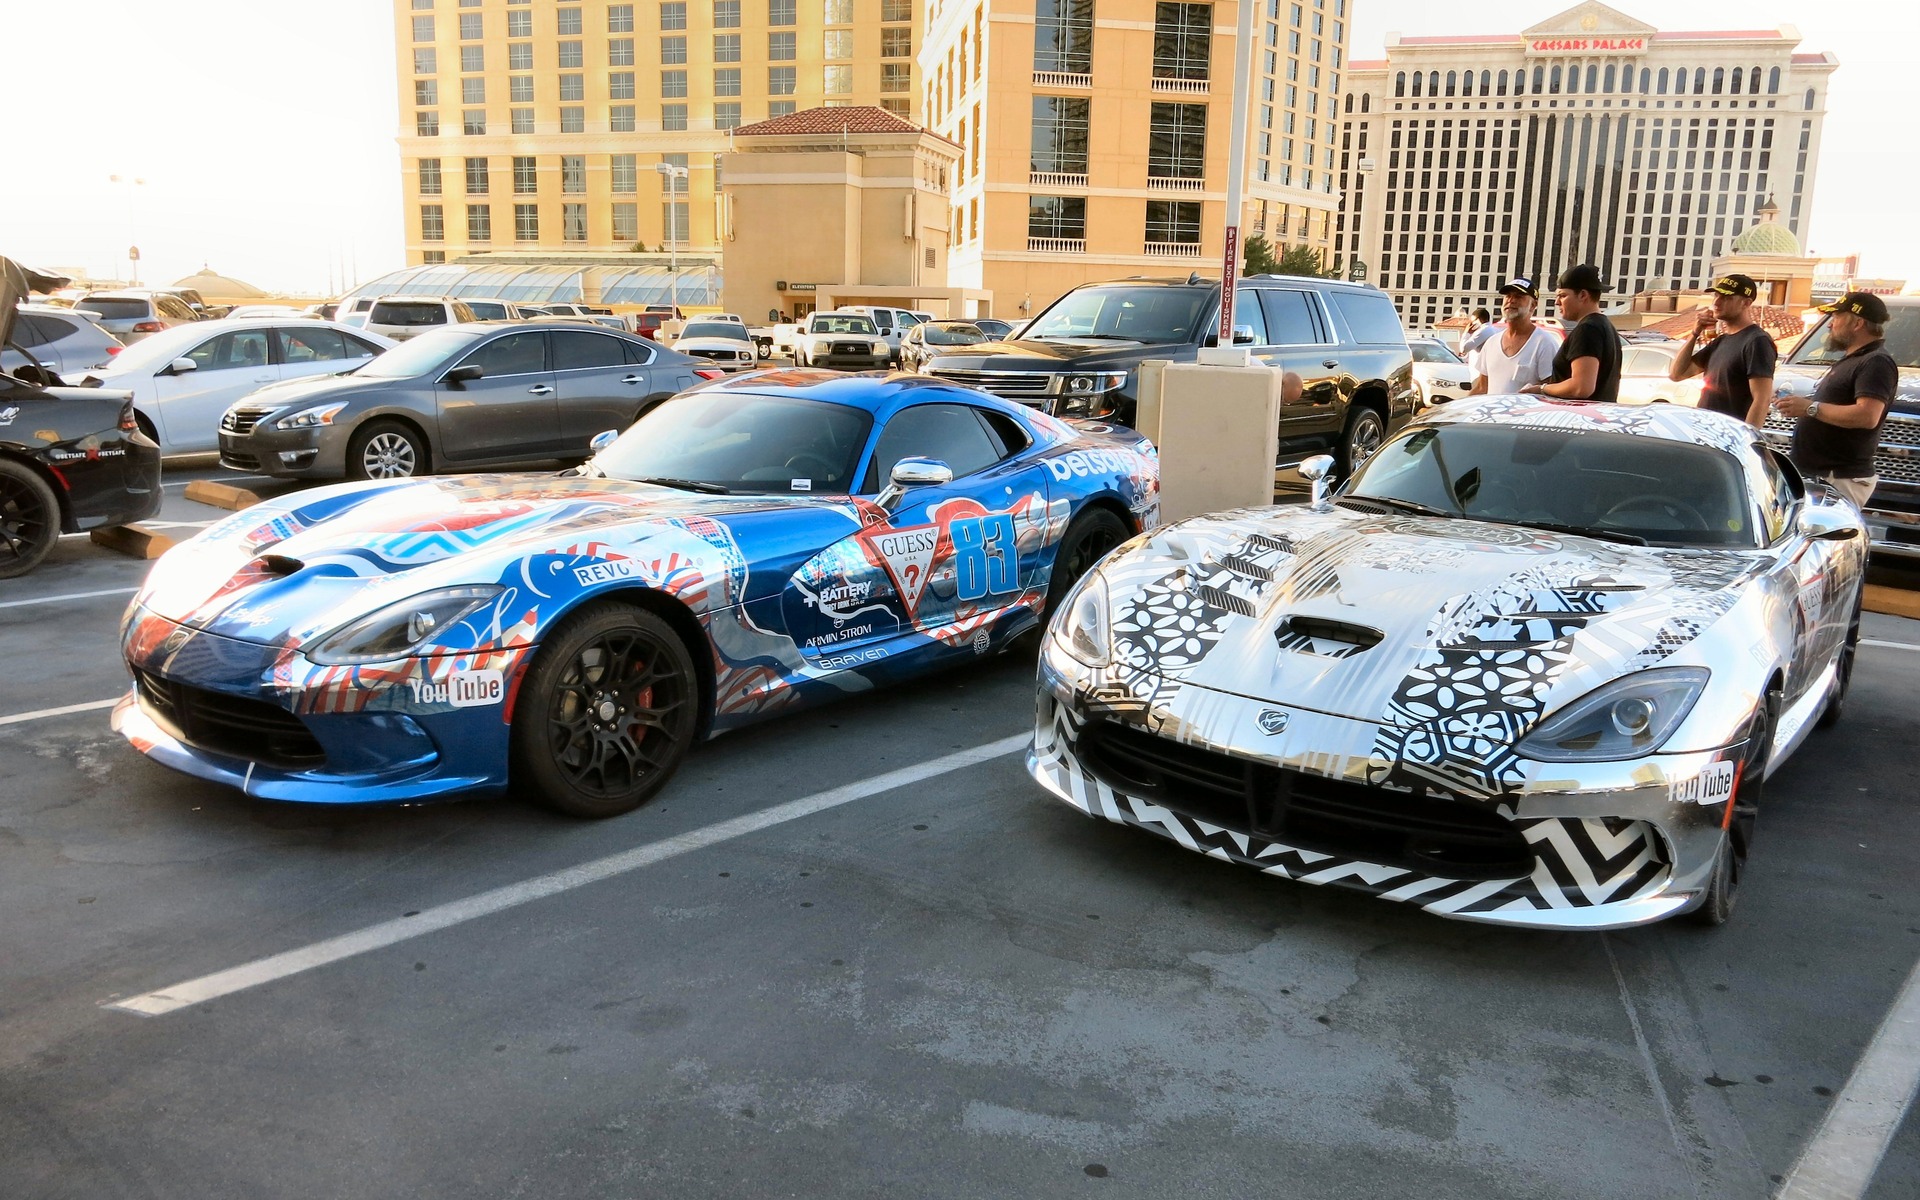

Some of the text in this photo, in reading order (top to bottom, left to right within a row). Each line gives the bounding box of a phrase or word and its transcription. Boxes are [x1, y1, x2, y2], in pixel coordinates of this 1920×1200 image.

[1532, 38, 1643, 51] CAESARS PALACE
[1813, 281, 1846, 289] MIRAGE
[1222, 265, 1233, 332] EXTINGUISHER
[881, 532, 934, 557] GUESS
[949, 513, 1021, 602] 83
[820, 581, 872, 603] BATTERY
[840, 623, 872, 640] STROM
[819, 647, 890, 670] BRAVEN
[411, 675, 500, 704] YouTube
[1665, 764, 1731, 803] YouTube
